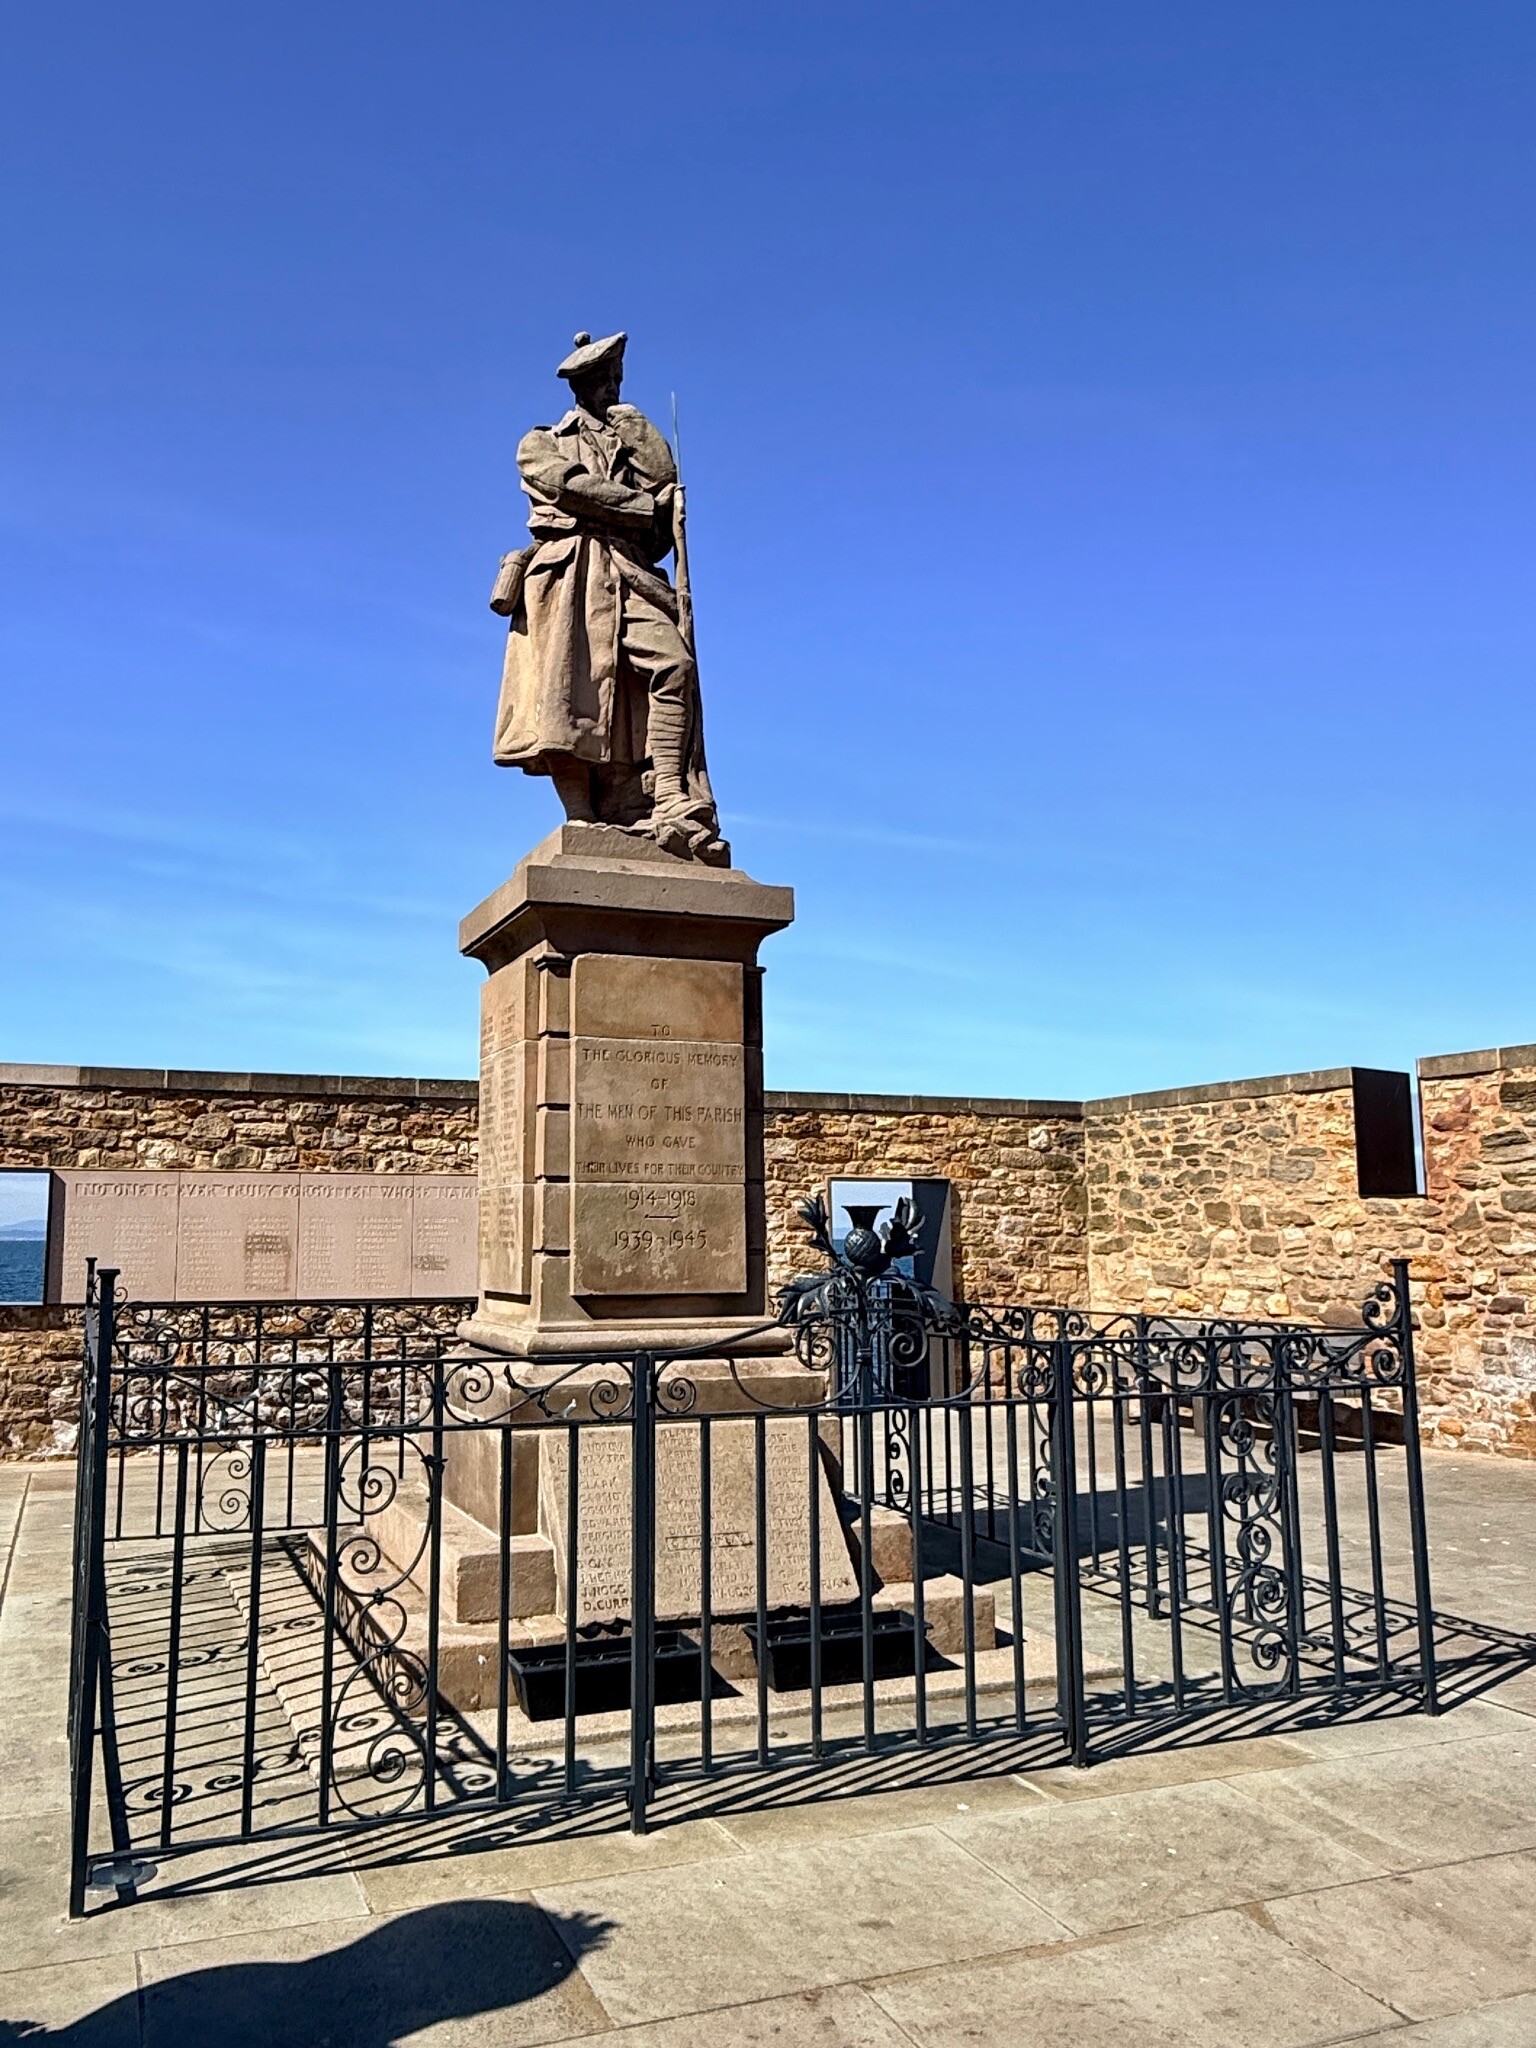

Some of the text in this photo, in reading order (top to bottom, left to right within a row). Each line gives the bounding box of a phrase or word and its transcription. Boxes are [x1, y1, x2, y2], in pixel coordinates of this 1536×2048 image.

[651, 1025, 671, 1037] TO
[583, 1049, 738, 1067] THE GLORIOUS MEMORY
[651, 1078, 669, 1090] OF
[577, 1103, 742, 1123] THE MEN OF THIS PARISH
[626, 1136, 696, 1149] WHO GAVE
[608, 1162, 639, 1175] LIVES
[644, 1163, 664, 1175] FOR
[698, 1164, 744, 1176] COUNTRY
